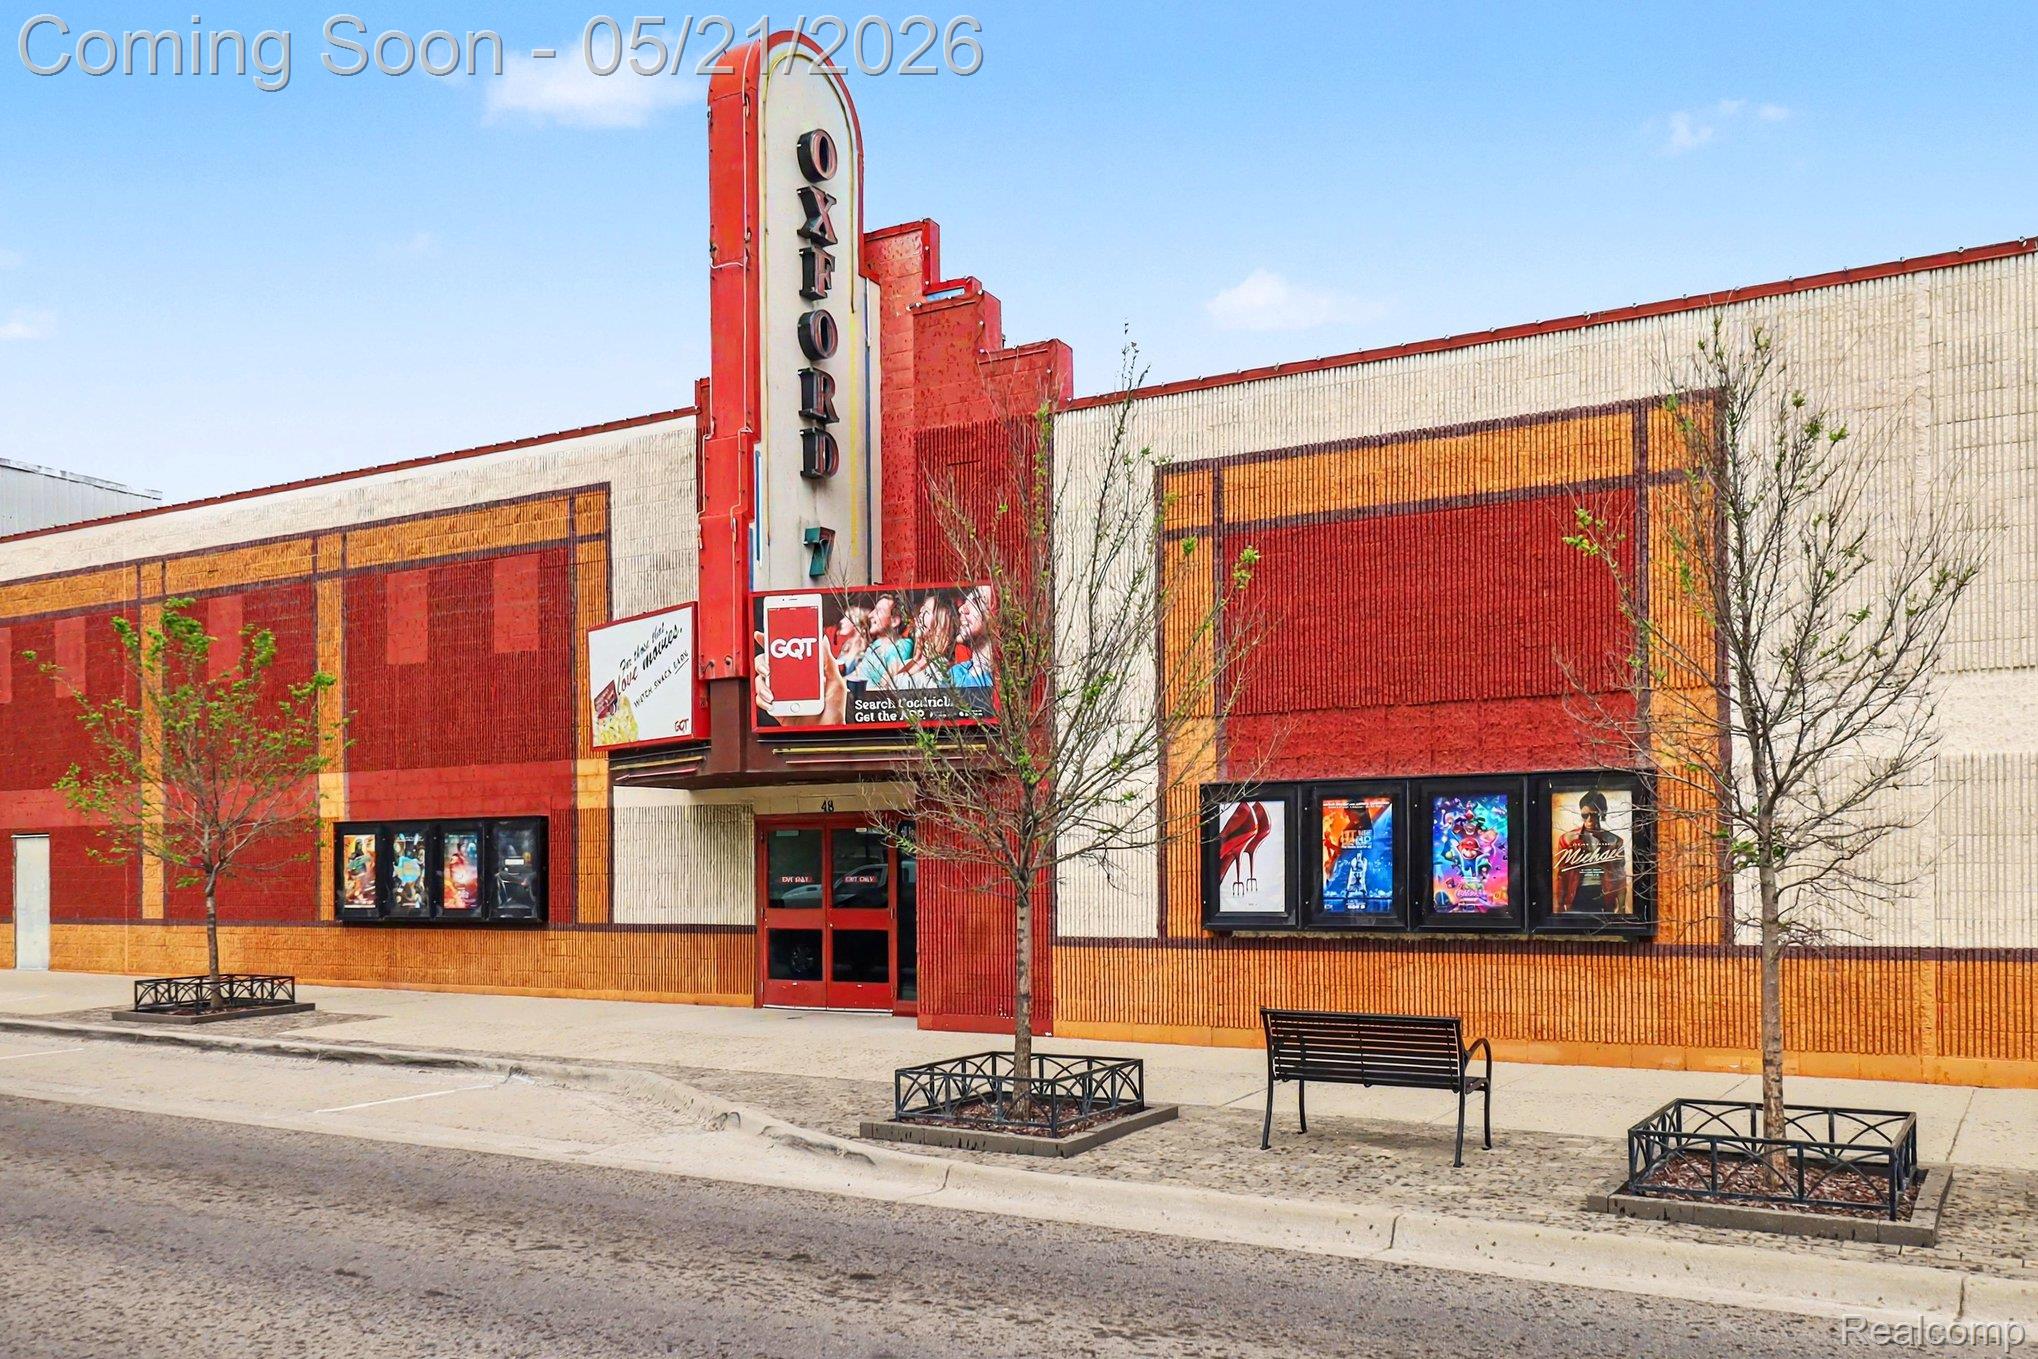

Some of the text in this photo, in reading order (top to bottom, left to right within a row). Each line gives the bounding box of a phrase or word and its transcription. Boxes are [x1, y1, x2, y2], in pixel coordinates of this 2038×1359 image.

[797, 128, 839, 480] OXFORD
[803, 527, 836, 577] 7
[770, 637, 818, 660] GQT
[617, 666, 639, 696] love
[855, 698, 896, 710] Search
[855, 712, 876, 722] Get
[878, 710, 897, 721] the
[821, 800, 834, 811] 48
[1554, 846, 1626, 869] Michael
